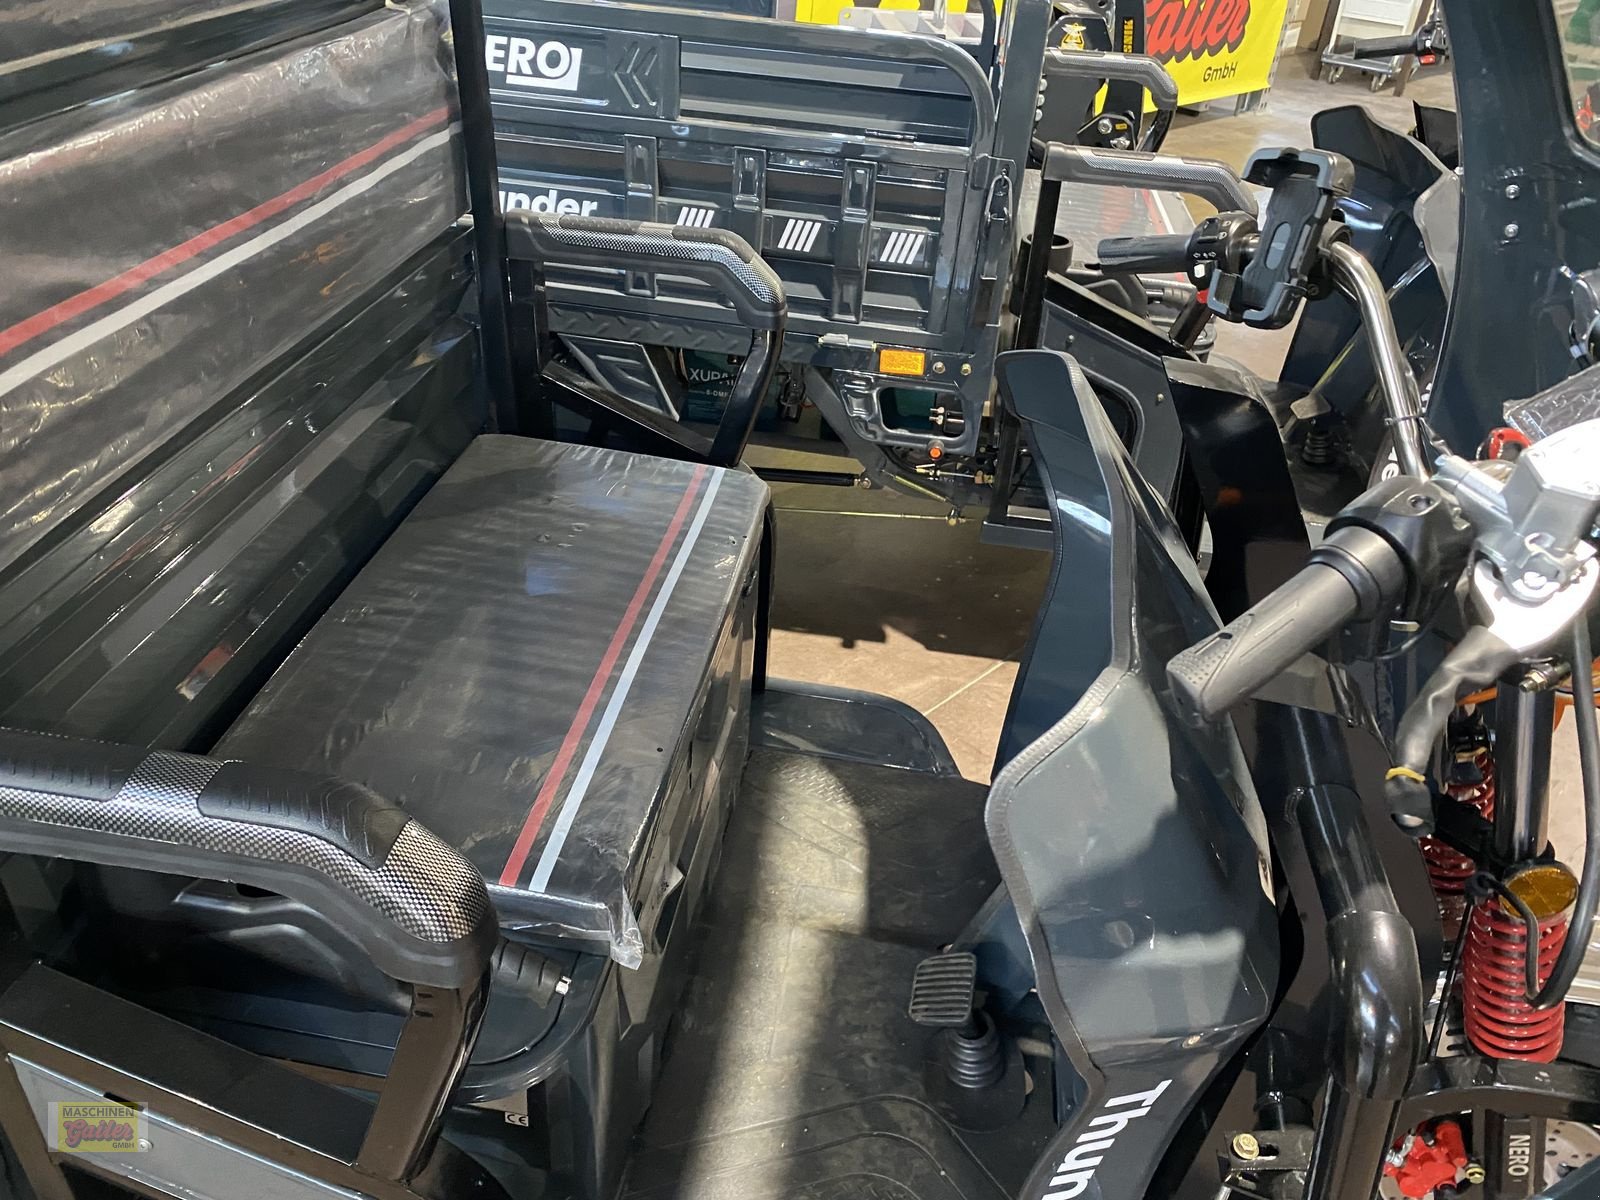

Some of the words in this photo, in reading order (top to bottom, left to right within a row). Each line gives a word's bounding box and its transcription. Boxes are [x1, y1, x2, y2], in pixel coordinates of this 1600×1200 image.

[1203, 61, 1239, 82] GmbH
[507, 1113, 528, 1126] CE
[1040, 1079, 1173, 1200] Thun
[1507, 1134, 1531, 1177] NERO
